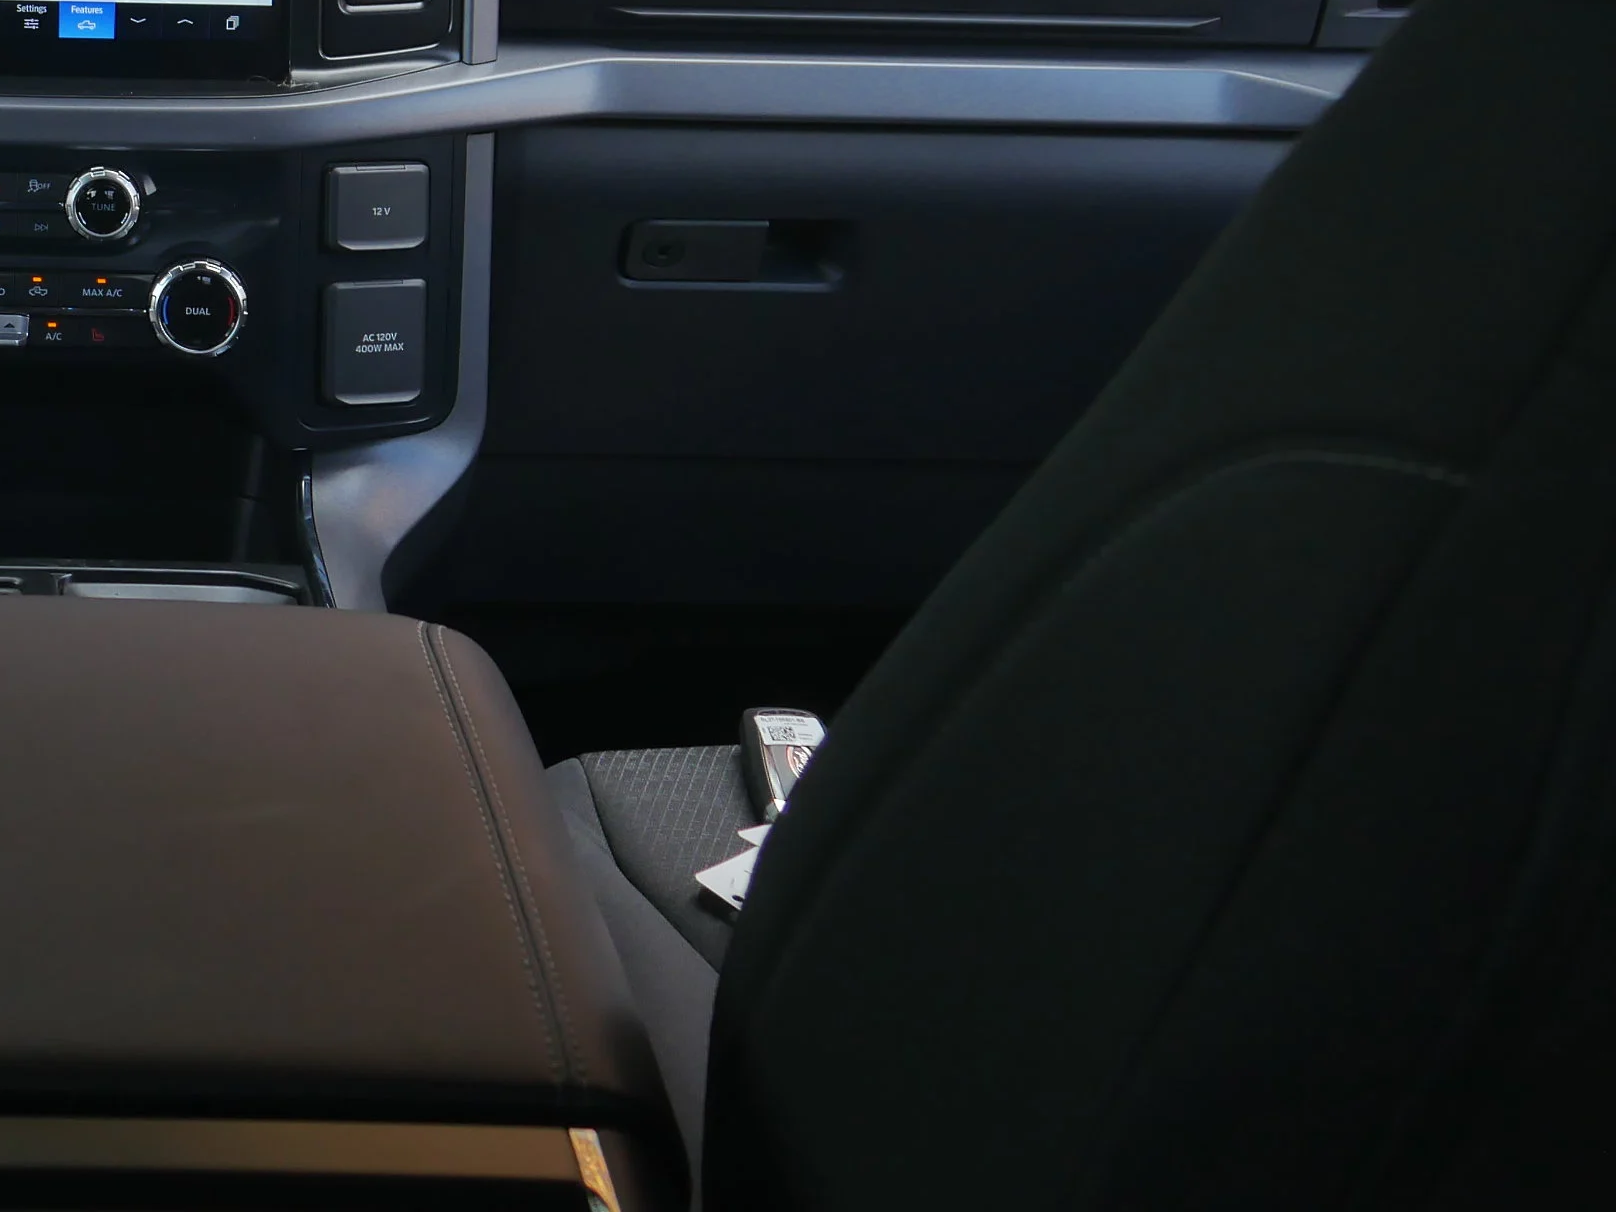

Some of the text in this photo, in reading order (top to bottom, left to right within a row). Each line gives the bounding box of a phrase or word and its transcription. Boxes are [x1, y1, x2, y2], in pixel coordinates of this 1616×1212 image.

[16, 4, 47, 14] Settings
[70, 5, 104, 14] Features
[91, 203, 116, 211] TUNE
[372, 207, 391, 216] 12 V
[82, 288, 123, 298] MAX A/C
[185, 307, 211, 316] DUAL
[45, 332, 62, 341] A/C
[362, 332, 398, 342] AC 120V
[355, 342, 404, 354] 400W MAX
